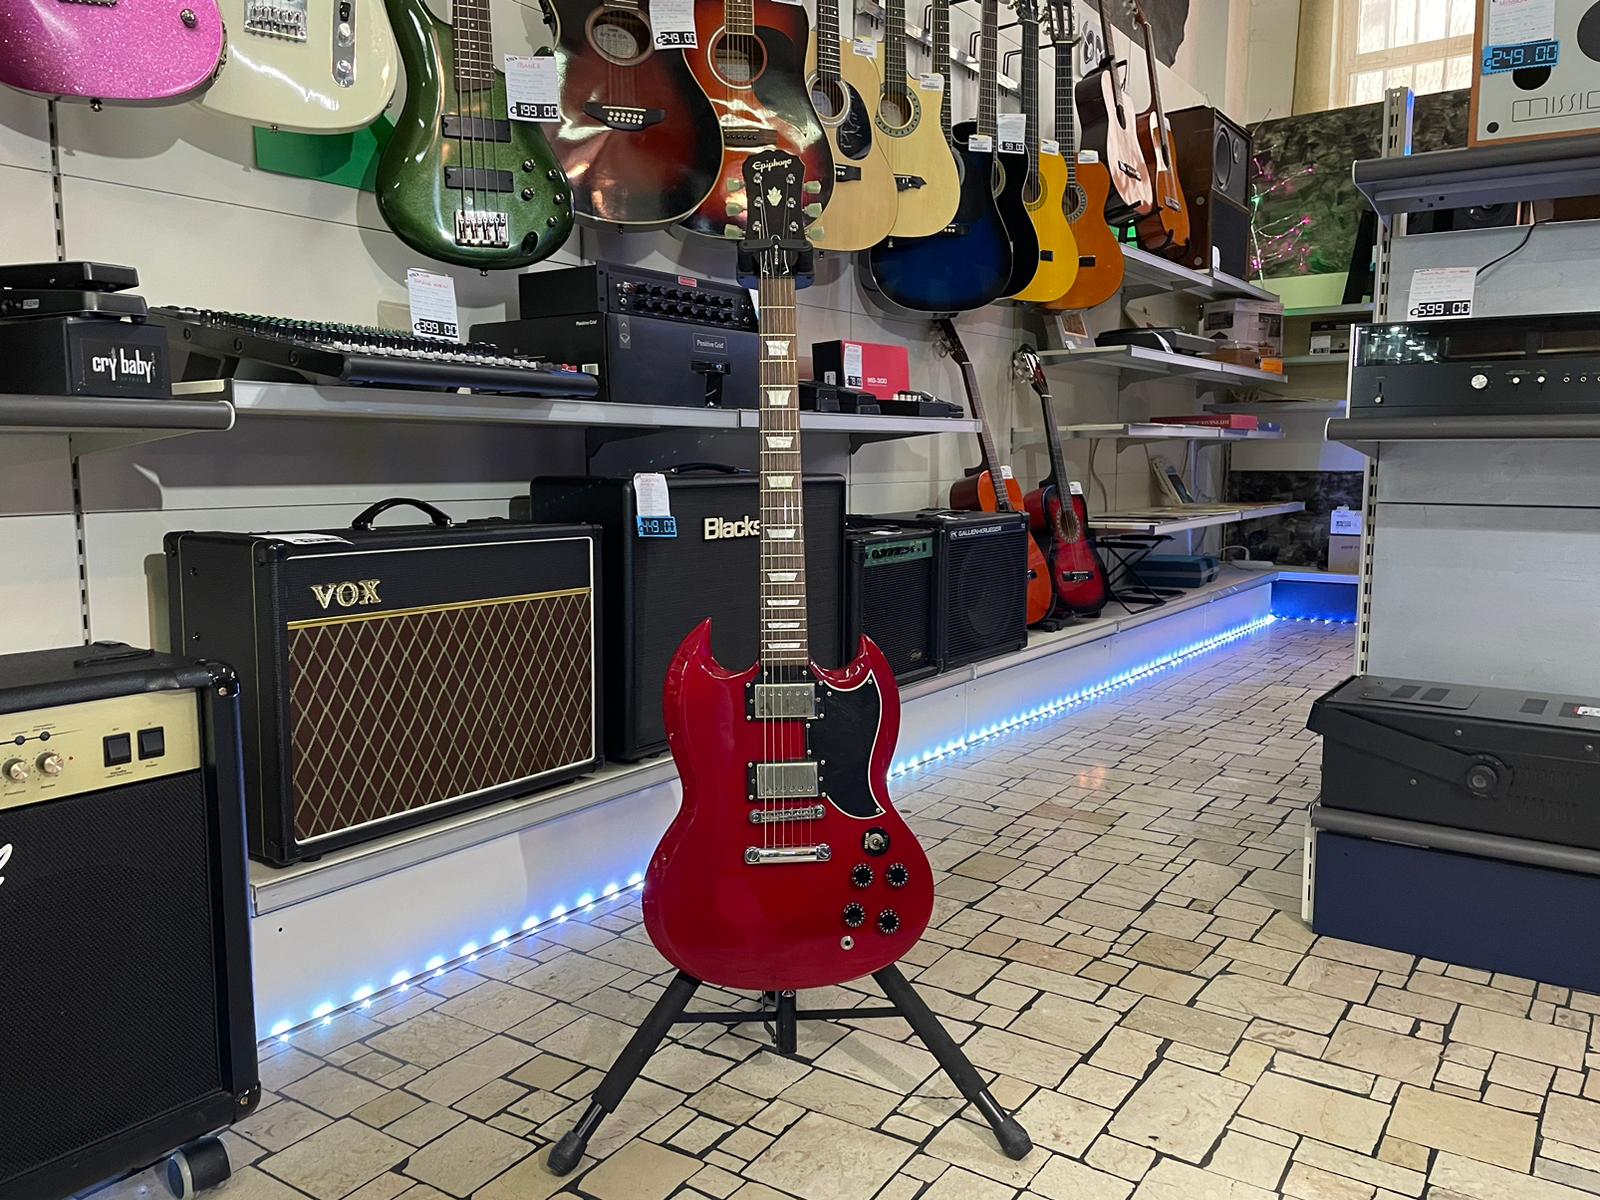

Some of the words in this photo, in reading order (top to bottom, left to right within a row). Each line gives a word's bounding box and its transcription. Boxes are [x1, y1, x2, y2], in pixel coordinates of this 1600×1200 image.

[752, 158, 792, 173] Epiphone
[92, 356, 117, 381] cry
[120, 348, 152, 383] baby
[310, 579, 382, 609] VOX
